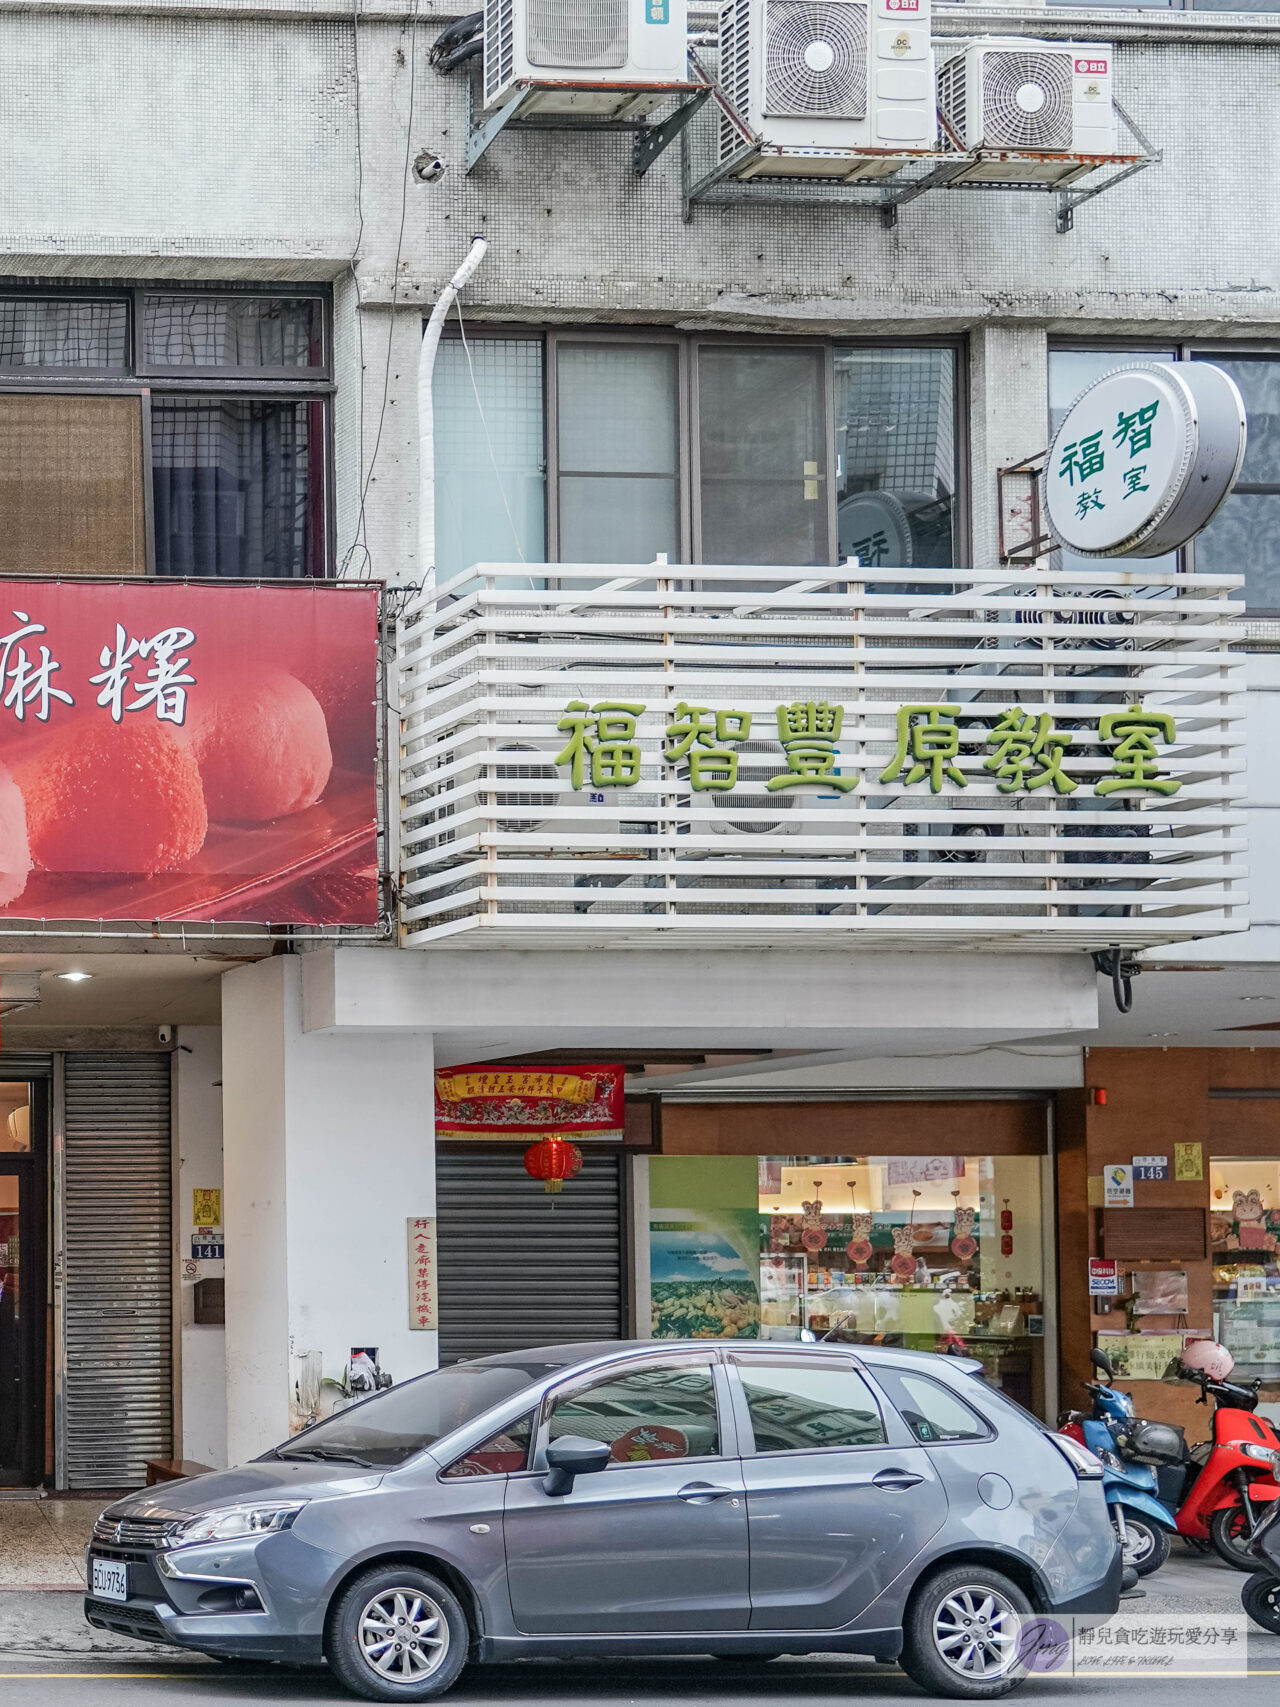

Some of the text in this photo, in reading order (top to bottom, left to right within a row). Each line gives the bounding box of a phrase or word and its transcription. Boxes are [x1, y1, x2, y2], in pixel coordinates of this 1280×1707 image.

[1090, 63, 1105, 71] 日立
[1059, 400, 1160, 486] 福智
[1074, 464, 1150, 521] 教室
[553, 699, 1184, 796] 福智豐原教室
[1140, 1166, 1163, 1180] 145
[197, 1245, 221, 1258] 141
[1092, 1278, 1115, 1286] SECOM
